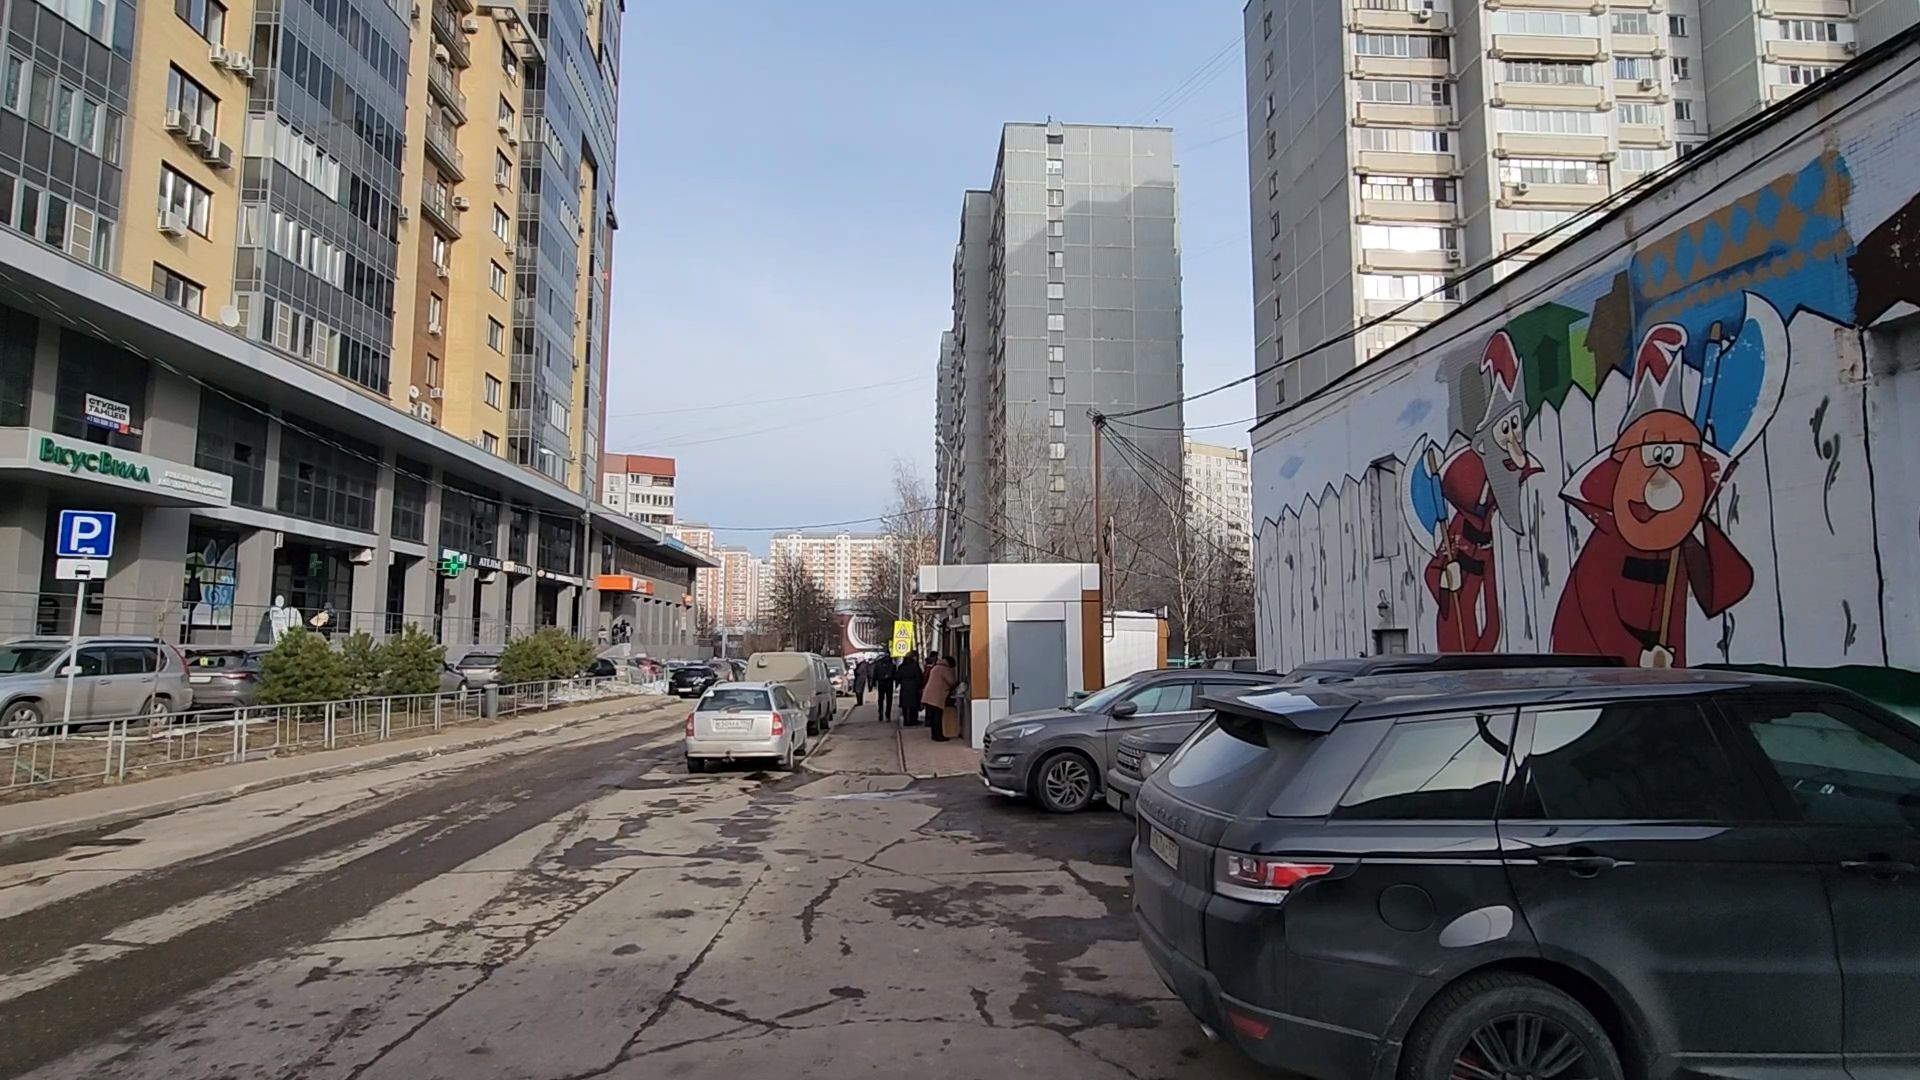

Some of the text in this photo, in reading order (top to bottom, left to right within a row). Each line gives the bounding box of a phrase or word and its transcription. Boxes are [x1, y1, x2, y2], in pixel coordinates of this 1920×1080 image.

[88, 398, 128, 415] СТУДИЯ
[88, 405, 127, 421] ТАНЦЕВ
[39, 437, 150, 483] ВкусВилл
[69, 516, 102, 551] P
